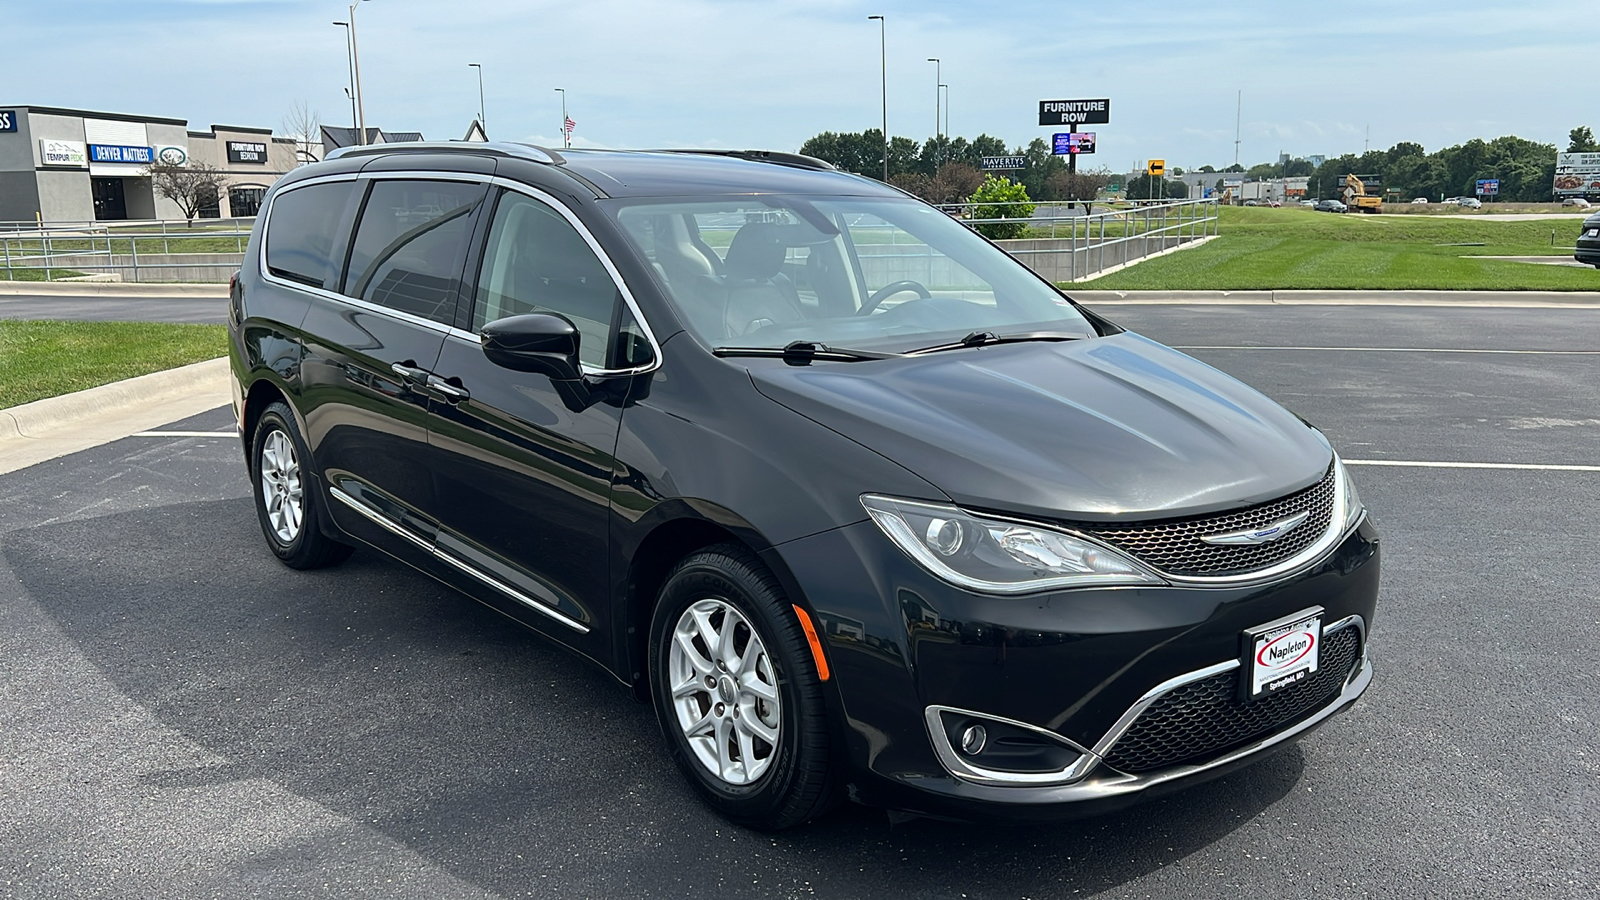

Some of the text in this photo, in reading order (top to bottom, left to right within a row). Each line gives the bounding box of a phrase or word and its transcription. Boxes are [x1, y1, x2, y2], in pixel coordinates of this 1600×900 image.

[1044, 102, 1105, 112] FURNITURE
[1061, 112, 1087, 122] ROW
[231, 143, 265, 152] FURNITURE ROW
[46, 153, 70, 162] TEMPUR
[96, 146, 121, 160] DENVER
[122, 147, 150, 162] MATTRESS
[1269, 640, 1307, 660] Napleton
[1296, 671, 1305, 680] MO
